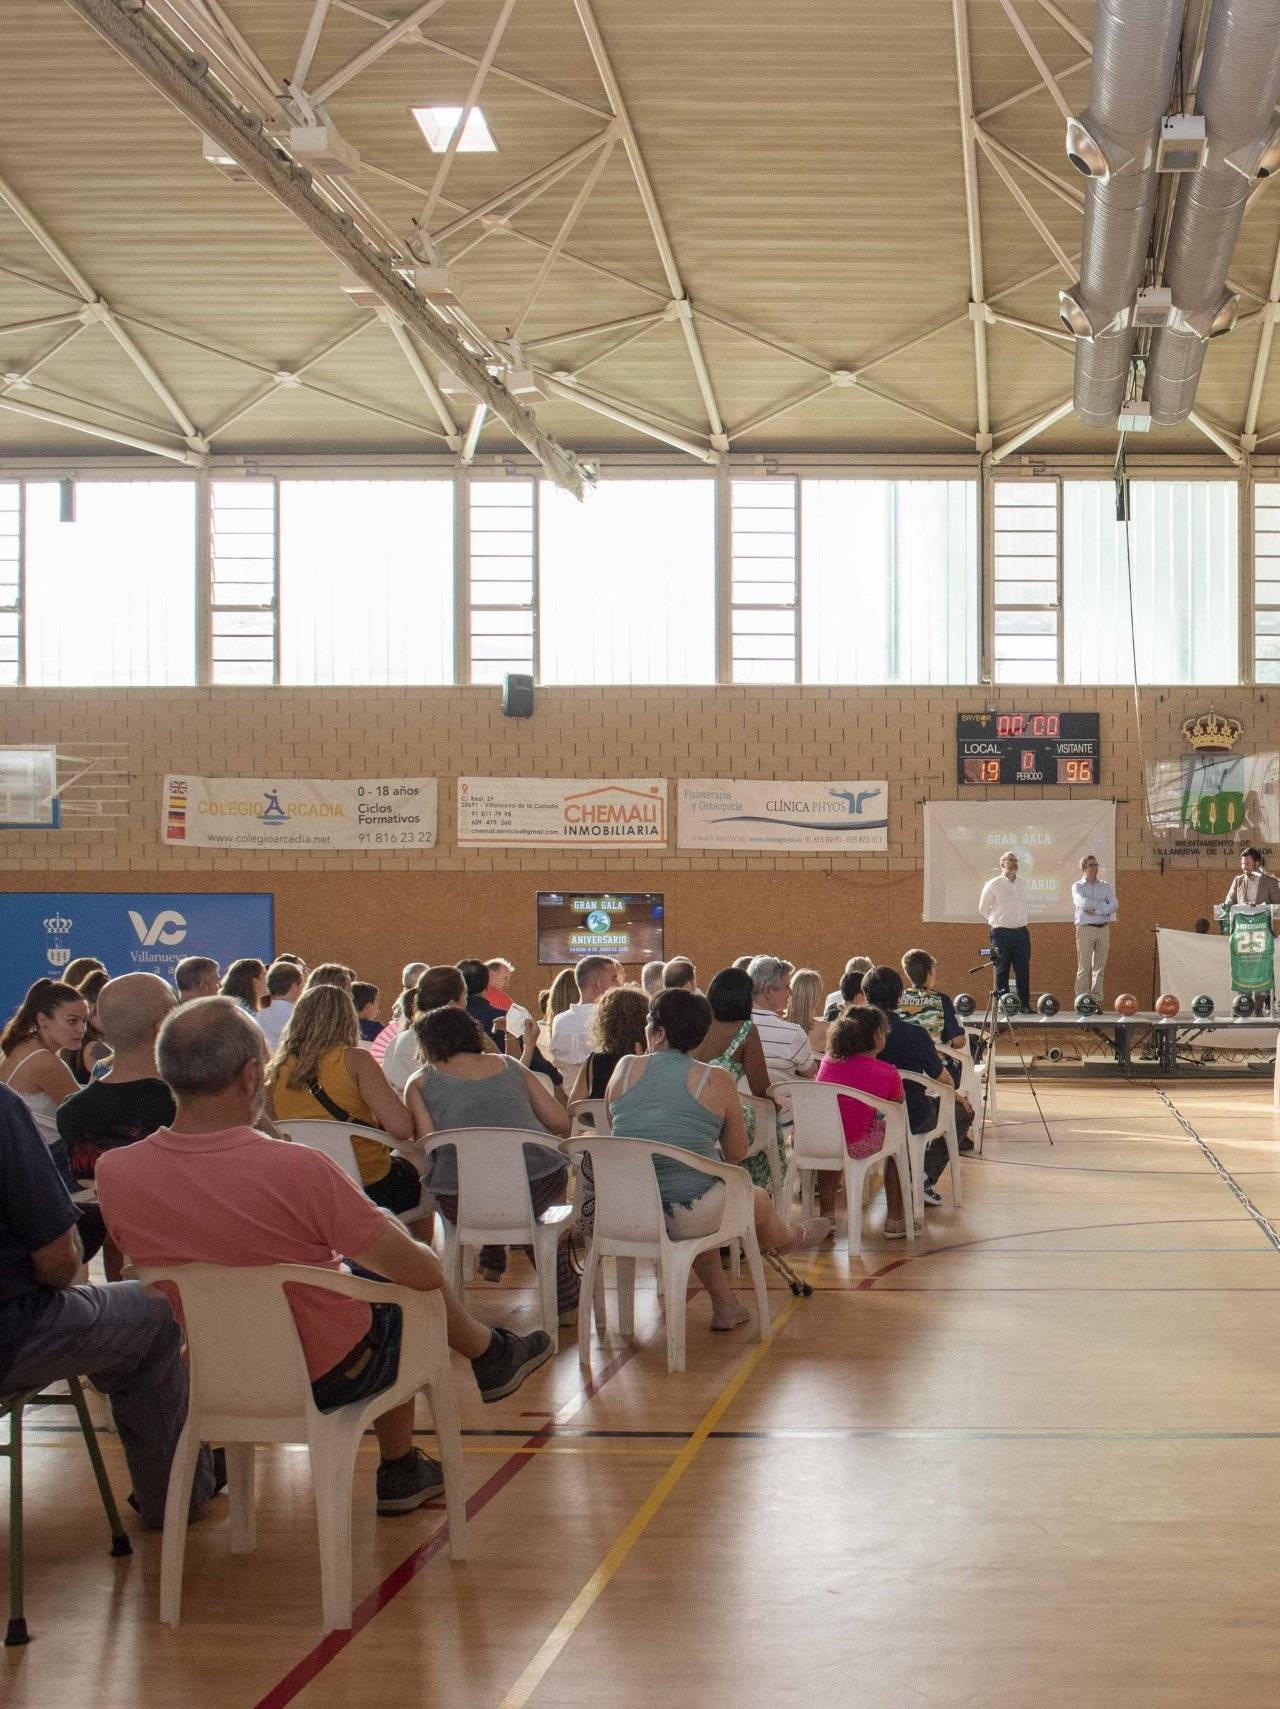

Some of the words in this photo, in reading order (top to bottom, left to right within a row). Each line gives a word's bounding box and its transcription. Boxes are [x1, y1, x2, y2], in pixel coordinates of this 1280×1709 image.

[964, 743, 1002, 754] LOCAL
[1056, 743, 1093, 754] VISITANTE
[1023, 752, 1034, 769] 0
[981, 761, 999, 781] 19
[1066, 761, 1090, 781] 96
[357, 786, 364, 797] 0
[376, 785, 389, 797] 18
[392, 785, 420, 797] años
[197, 801, 263, 816] COLEGIO
[357, 802, 393, 814] Ciclos
[766, 798, 810, 813] CLÍNICA
[812, 802, 846, 813] PHYOS
[358, 814, 421, 825] Formativos
[564, 803, 656, 824] CHEMALI
[564, 825, 659, 836] INMOBILIARIA
[207, 833, 331, 845] www.colegioarcadia.net
[358, 832, 371, 844] 91
[375, 832, 398, 843] 816
[400, 832, 415, 843] 23
[418, 831, 433, 842] 22
[574, 901, 597, 910] GRAN
[601, 901, 623, 910] GALA
[571, 935, 628, 944] ANIVERSARIO
[1237, 930, 1266, 953] 25
